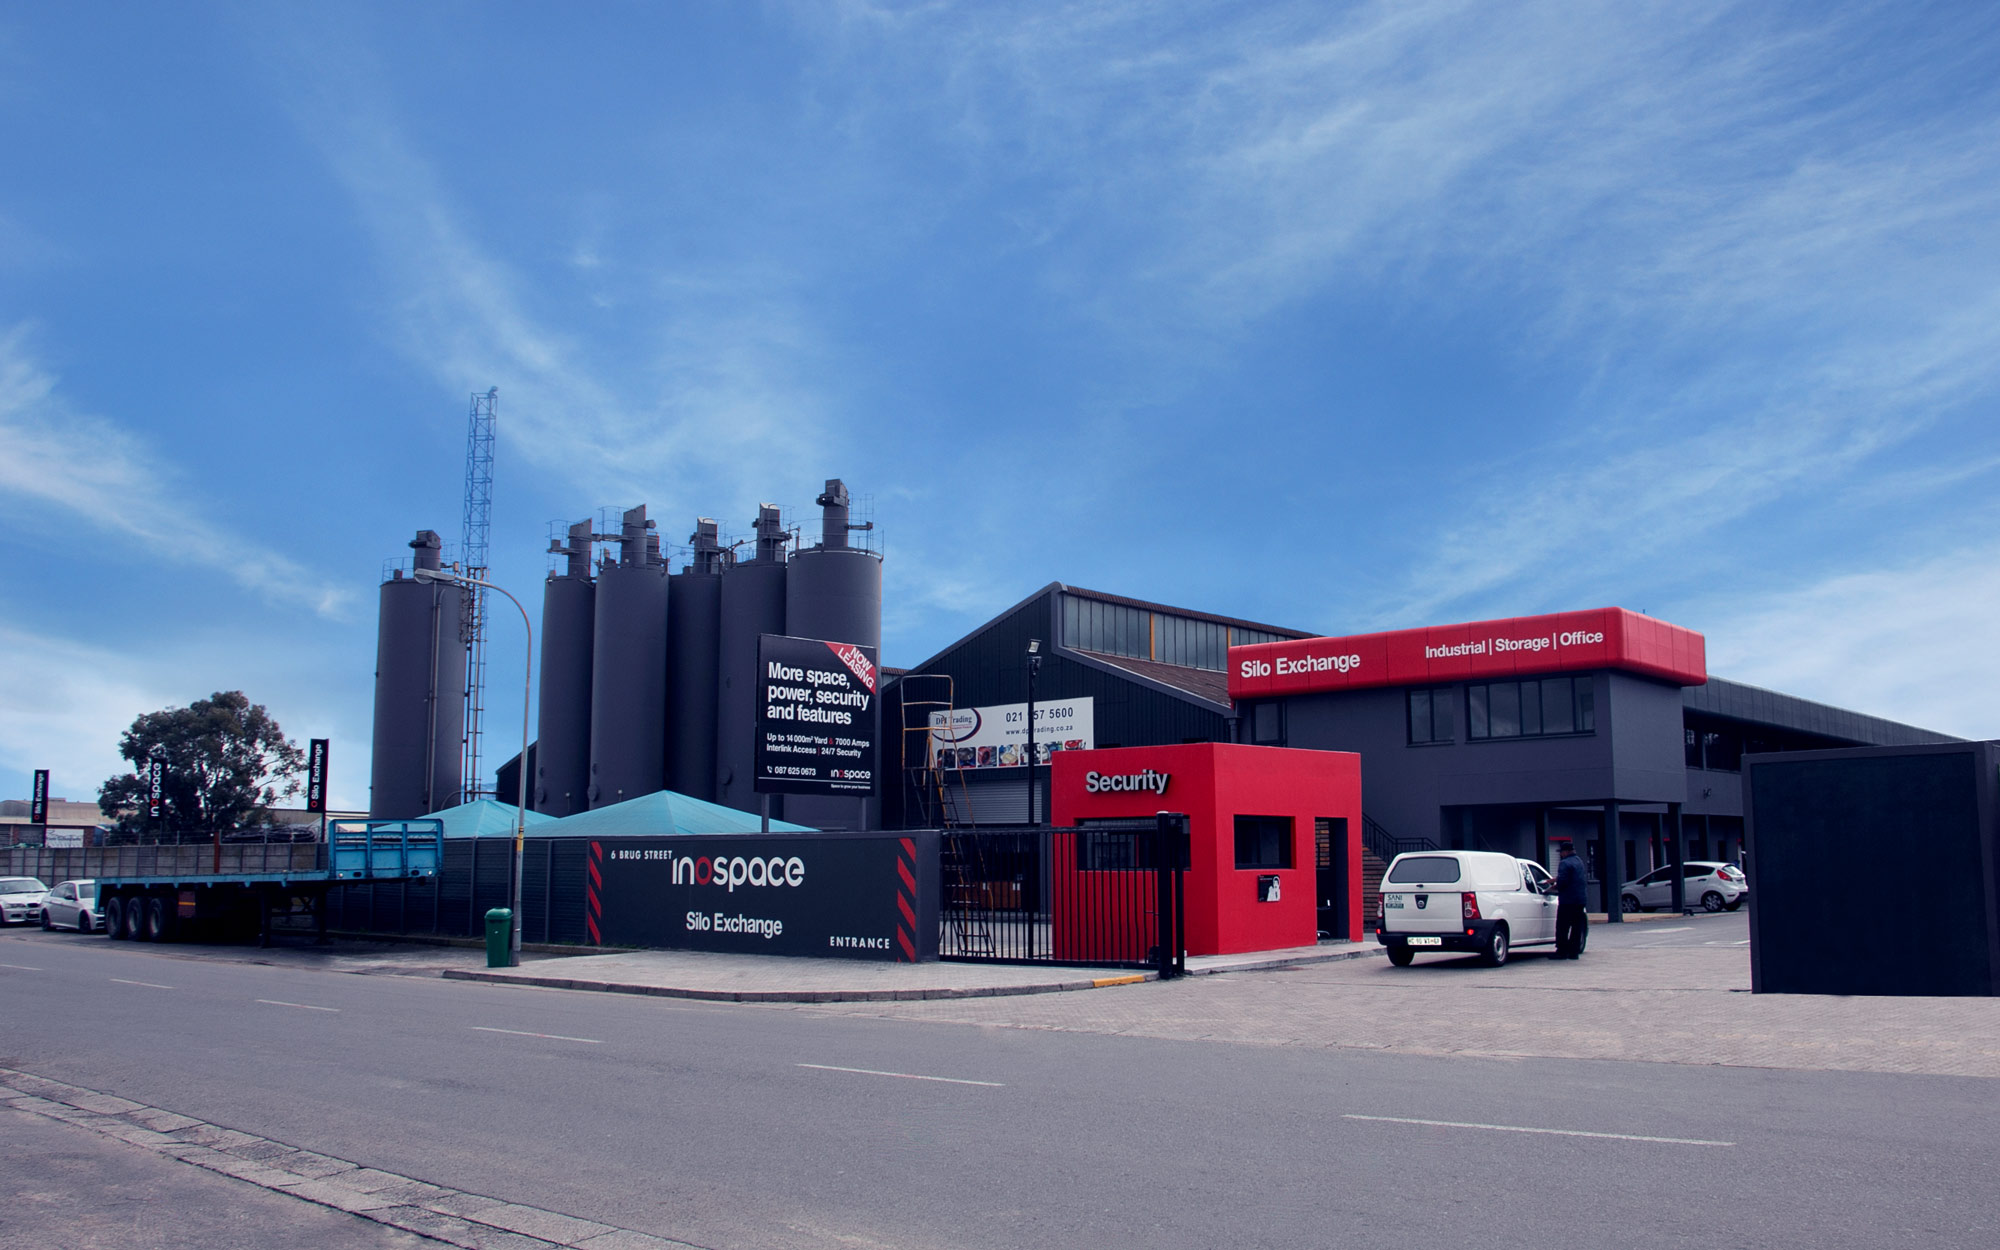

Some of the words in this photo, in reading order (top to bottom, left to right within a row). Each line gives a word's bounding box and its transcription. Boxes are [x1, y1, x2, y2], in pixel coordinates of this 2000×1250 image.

[1425, 641, 1486, 658] Industrial
[1495, 637, 1550, 652] Storage
[1560, 632, 1603, 646] Office
[837, 647, 874, 688] LEASING
[850, 647, 873, 672] NOW
[1241, 660, 1271, 678] Silo
[1276, 654, 1360, 674] Exchange
[768, 662, 804, 681] More
[806, 670, 850, 690] space,
[768, 685, 813, 705] power,
[816, 690, 870, 711] security
[767, 704, 794, 720] and
[797, 704, 852, 725] features
[1006, 712, 1022, 722] 021
[1049, 707, 1073, 719] 5600
[766, 744, 792, 752] Interlink
[793, 745, 816, 754] Access
[821, 747, 836, 755] 24/7
[836, 748, 861, 759] Security
[767, 733, 776, 742] Up
[814, 736, 828, 744] Yard
[835, 738, 851, 746] 7000
[852, 739, 870, 748] Amps
[312, 744, 323, 783] Exchange
[830, 769, 871, 780] inospace
[151, 762, 162, 816] inospace
[311, 784, 319, 799] Silo
[1086, 769, 1168, 794] Security
[610, 850, 616, 859] 6
[620, 850, 641, 859] BRUG
[644, 850, 672, 860] STREET
[672, 856, 805, 892] inospace
[686, 911, 711, 931] Silo
[714, 912, 782, 939] Exchange
[830, 936, 890, 949] ENTRANCE
